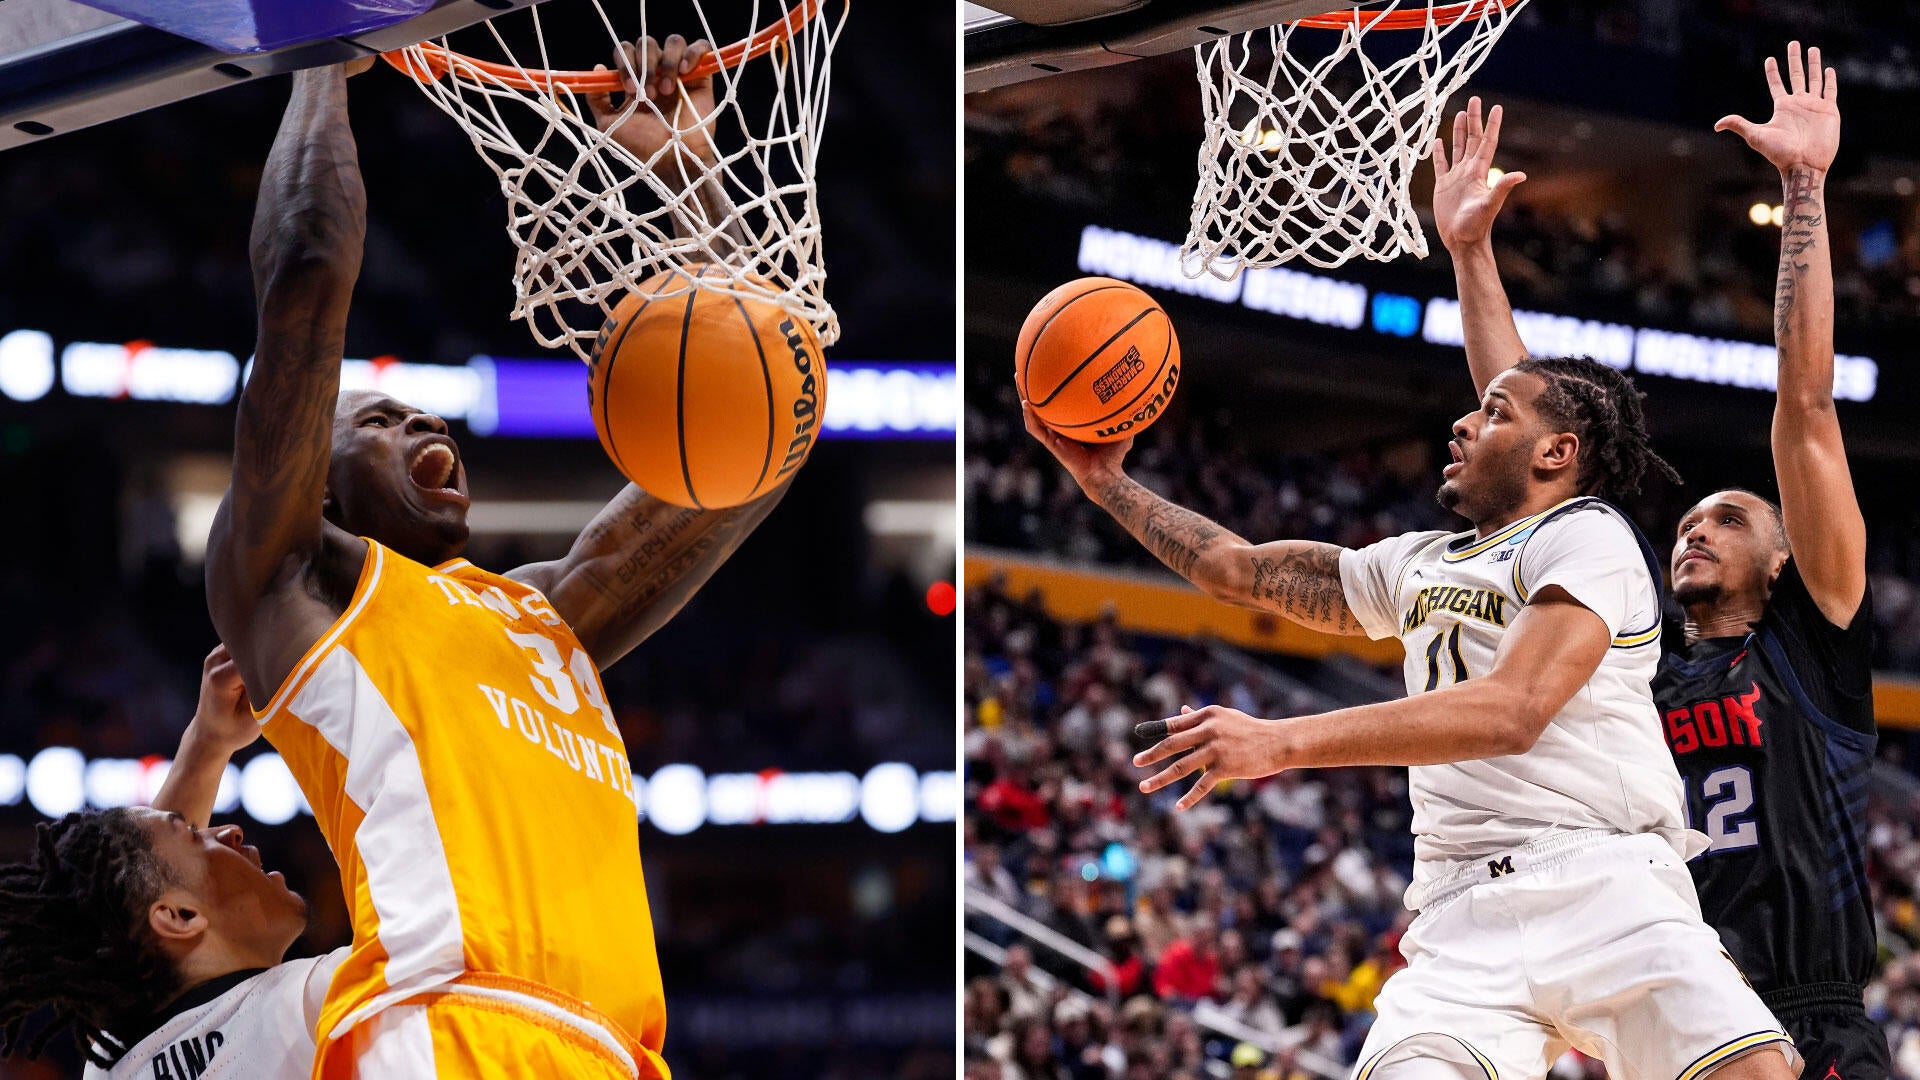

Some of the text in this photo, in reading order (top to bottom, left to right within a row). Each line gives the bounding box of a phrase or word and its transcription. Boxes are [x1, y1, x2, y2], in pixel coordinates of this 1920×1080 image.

[774, 317, 818, 480] Wilson
[1094, 364, 1179, 437] Wilson
[504, 628, 624, 743] 34
[1424, 622, 1470, 693] 11
[1659, 680, 1762, 754] SON
[1681, 763, 1760, 858] 2
[1487, 855, 1516, 879] M
